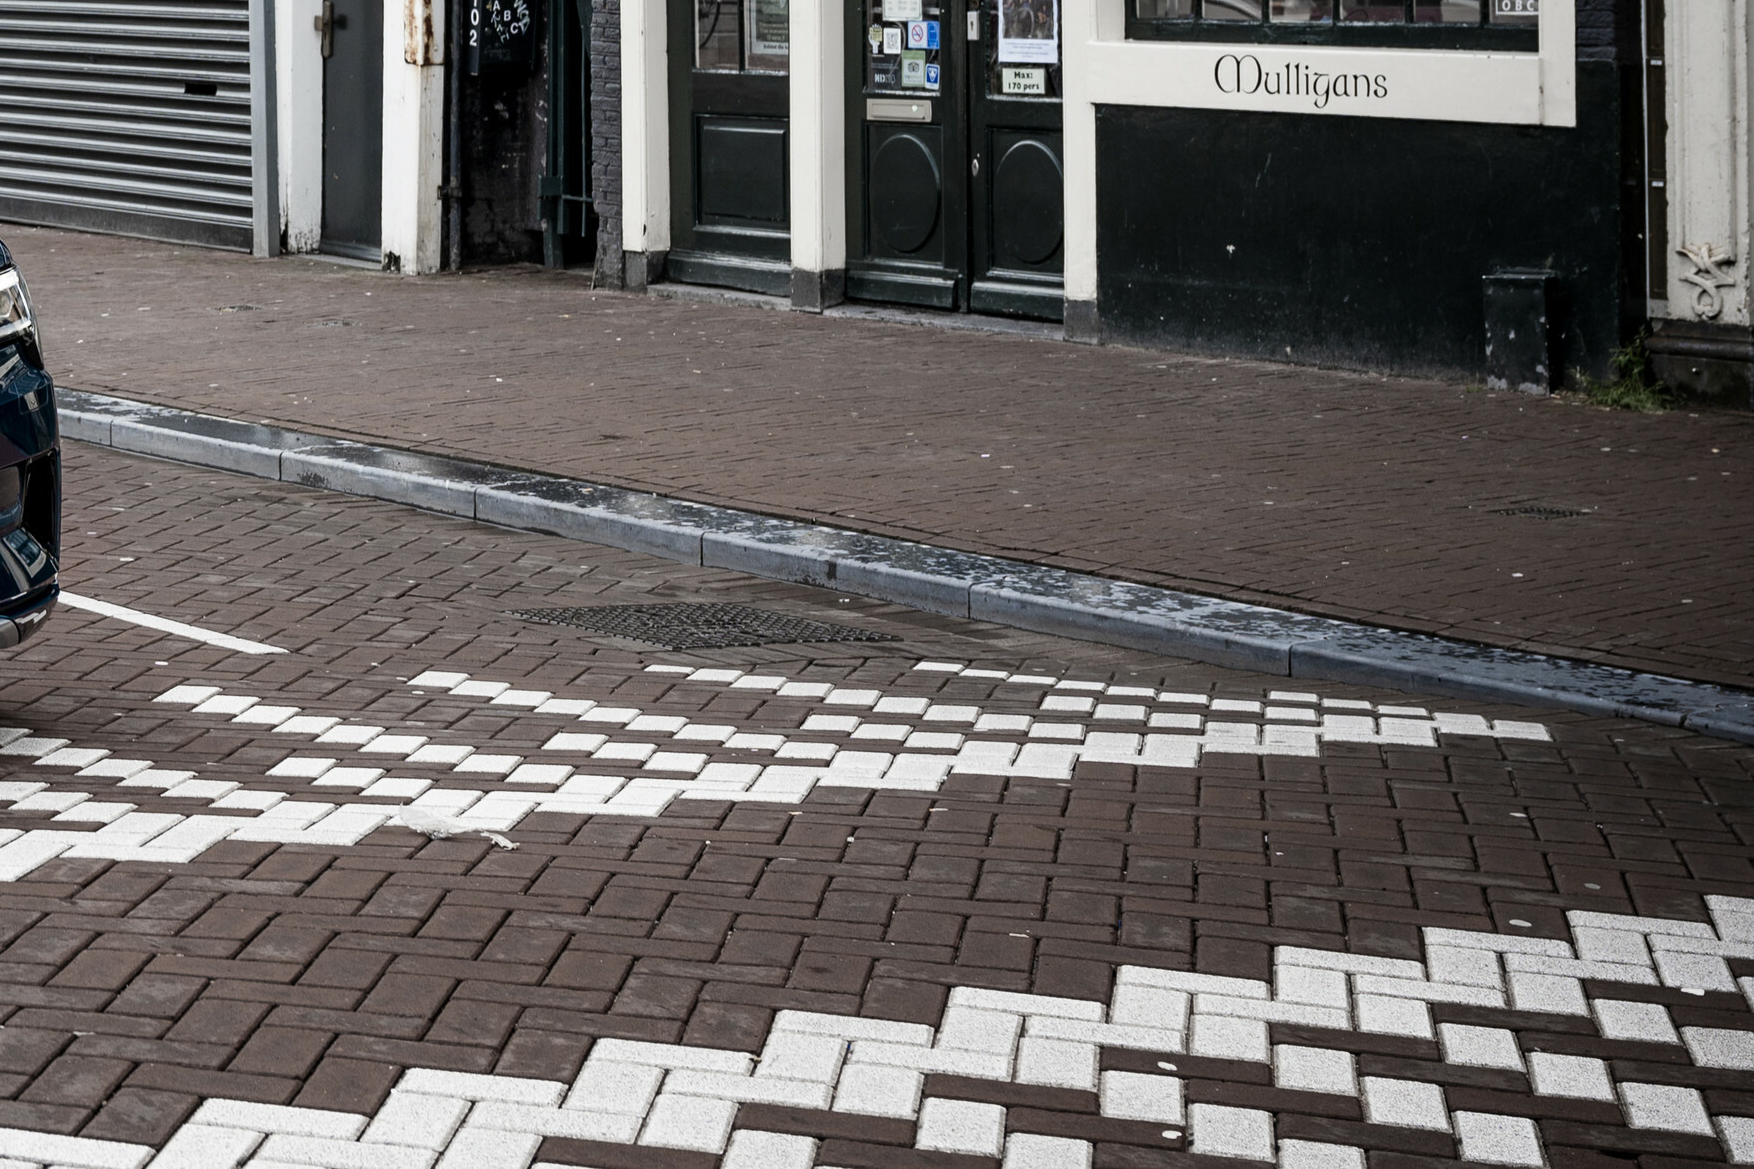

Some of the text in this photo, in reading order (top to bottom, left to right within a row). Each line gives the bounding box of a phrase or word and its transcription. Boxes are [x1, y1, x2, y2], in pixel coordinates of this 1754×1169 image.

[1014, 70, 1033, 79] Max:
[1214, 54, 1388, 109] Mulligans
[1008, 82, 1040, 92] 170 pers
